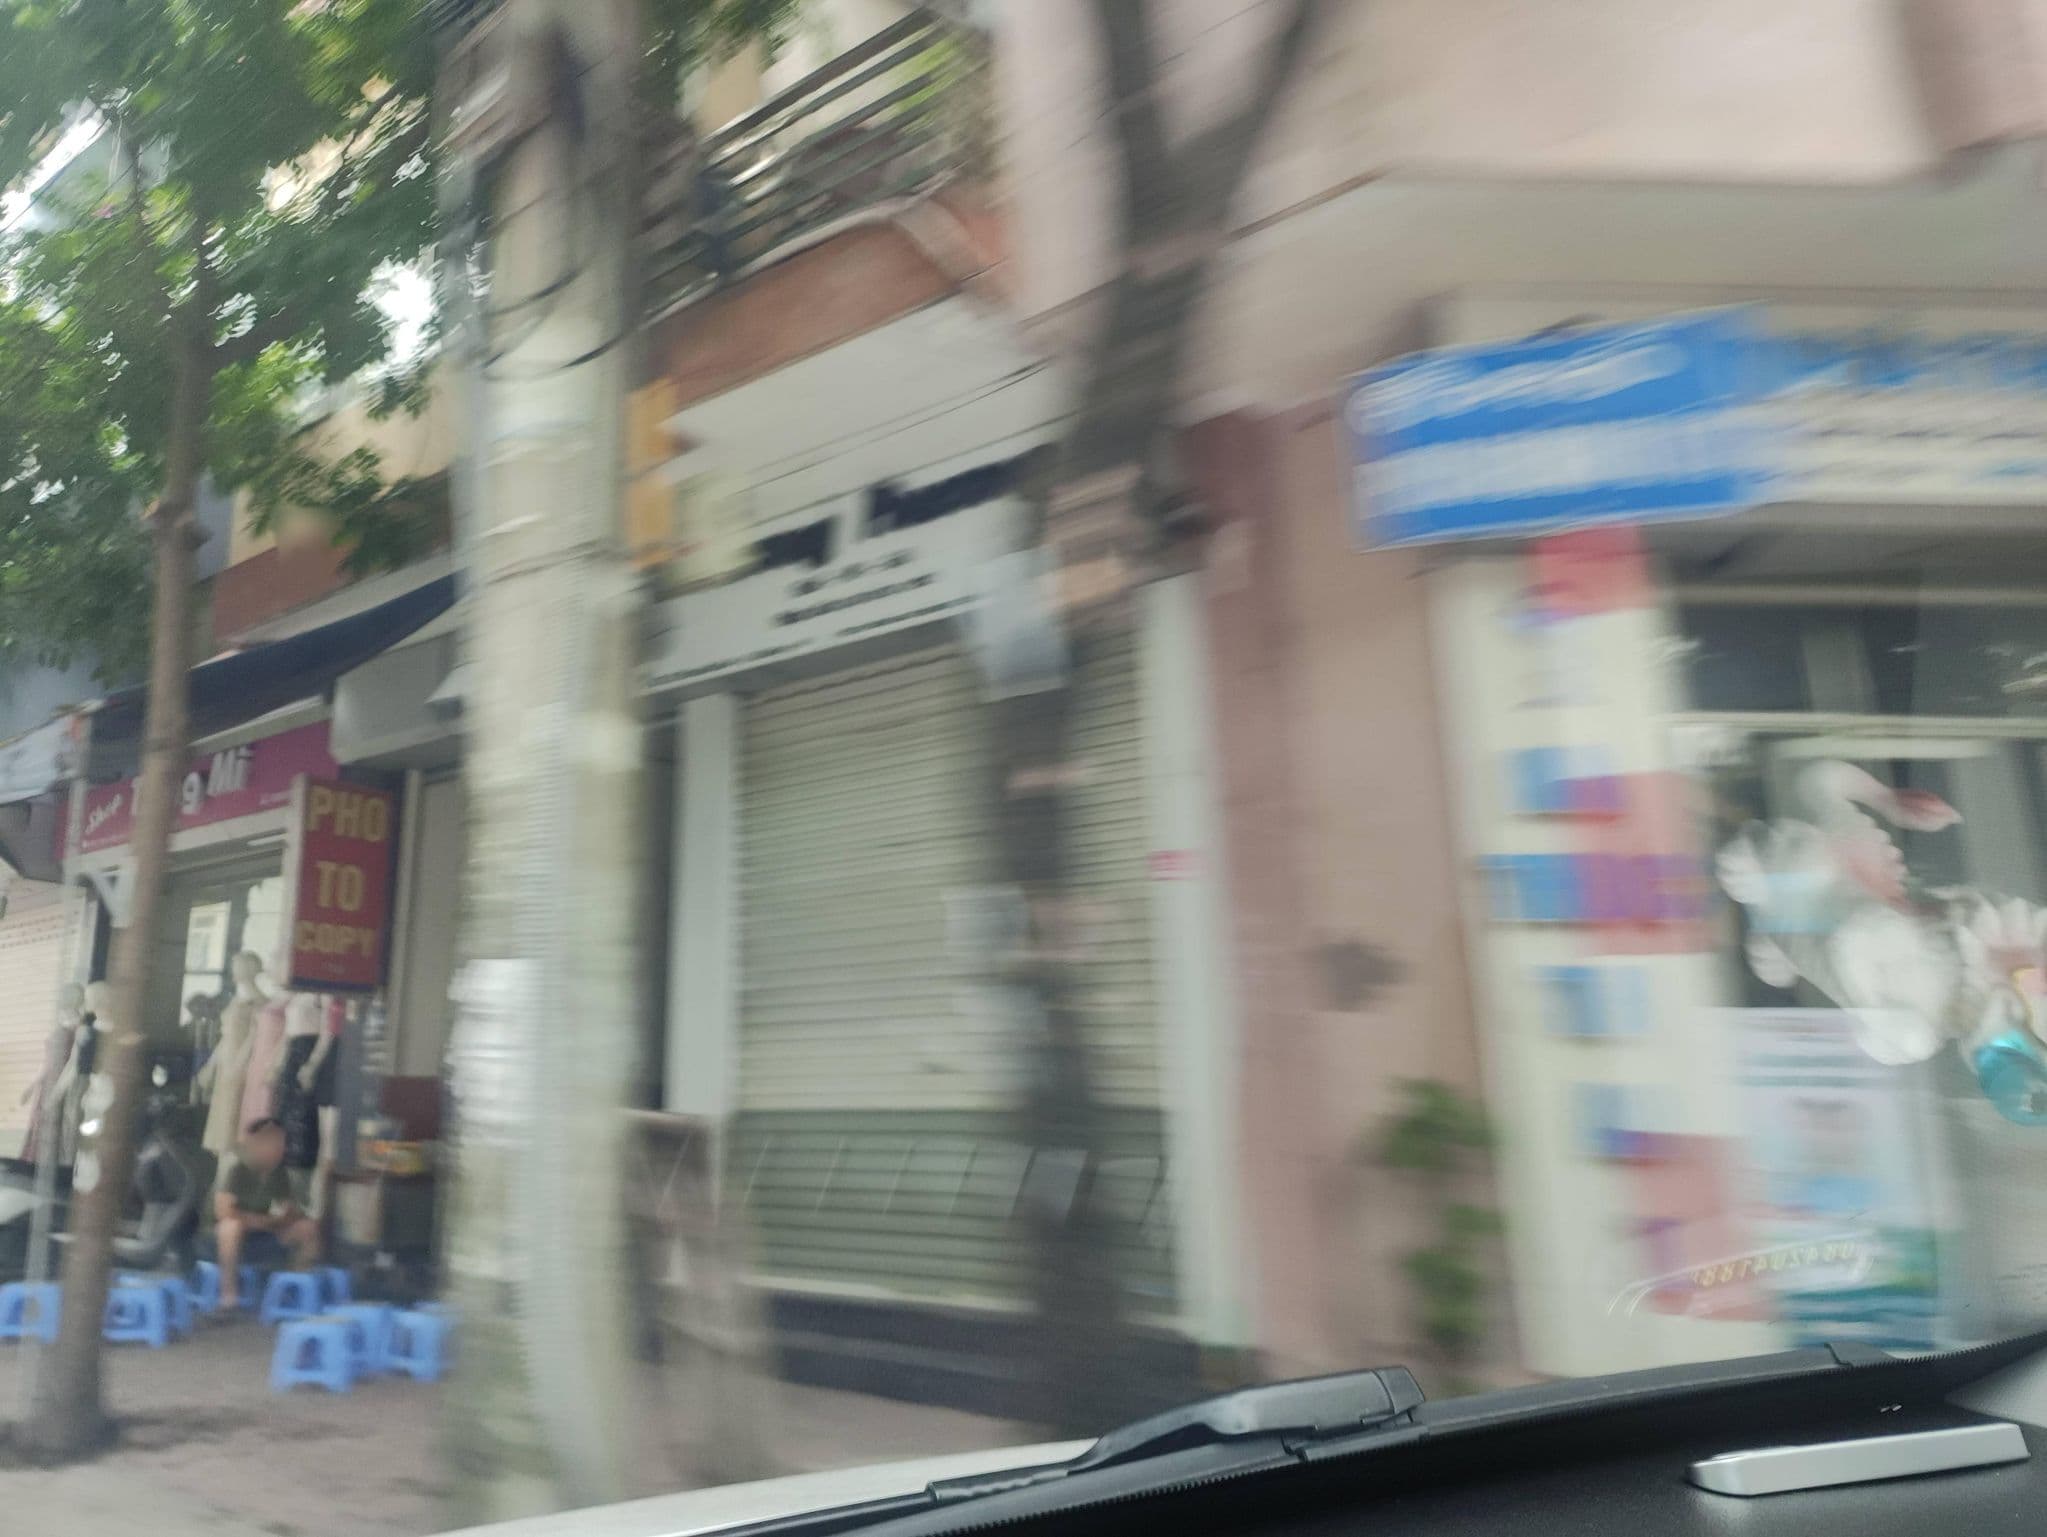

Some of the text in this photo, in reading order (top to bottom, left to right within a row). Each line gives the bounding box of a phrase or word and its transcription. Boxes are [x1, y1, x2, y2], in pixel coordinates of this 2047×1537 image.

[306, 784, 388, 842] PHO
[317, 860, 365, 912] TO
[295, 919, 375, 956] COPY
